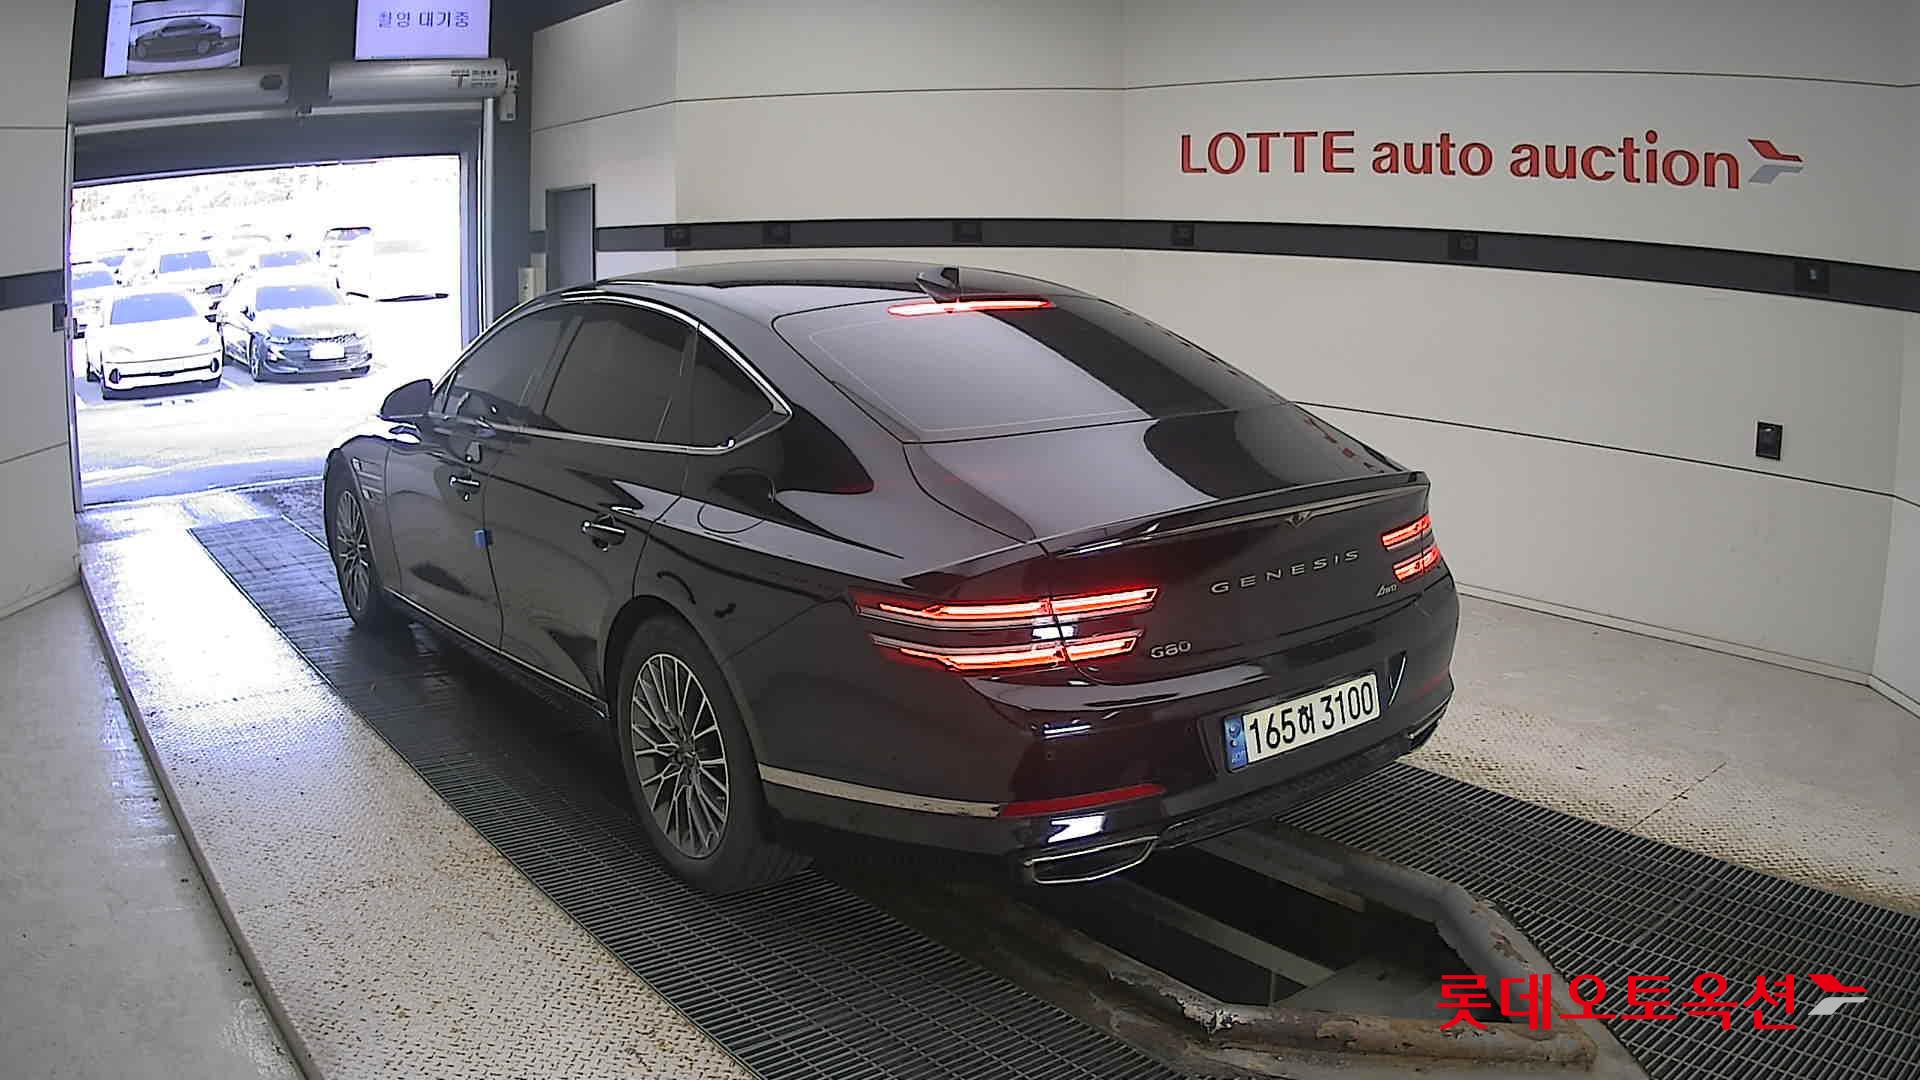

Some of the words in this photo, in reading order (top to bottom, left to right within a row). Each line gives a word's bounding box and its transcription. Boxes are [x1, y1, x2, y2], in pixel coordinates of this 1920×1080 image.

[418, 10, 470, 29] 대기중
[1179, 130, 1356, 175] LOTTE
[1371, 132, 1494, 177] auto
[1509, 129, 1741, 190] auction
[1210, 550, 1359, 594] GENESIS
[1151, 640, 1191, 658] G80
[1249, 702, 1316, 754] 165허
[1319, 681, 1374, 730] 3100
